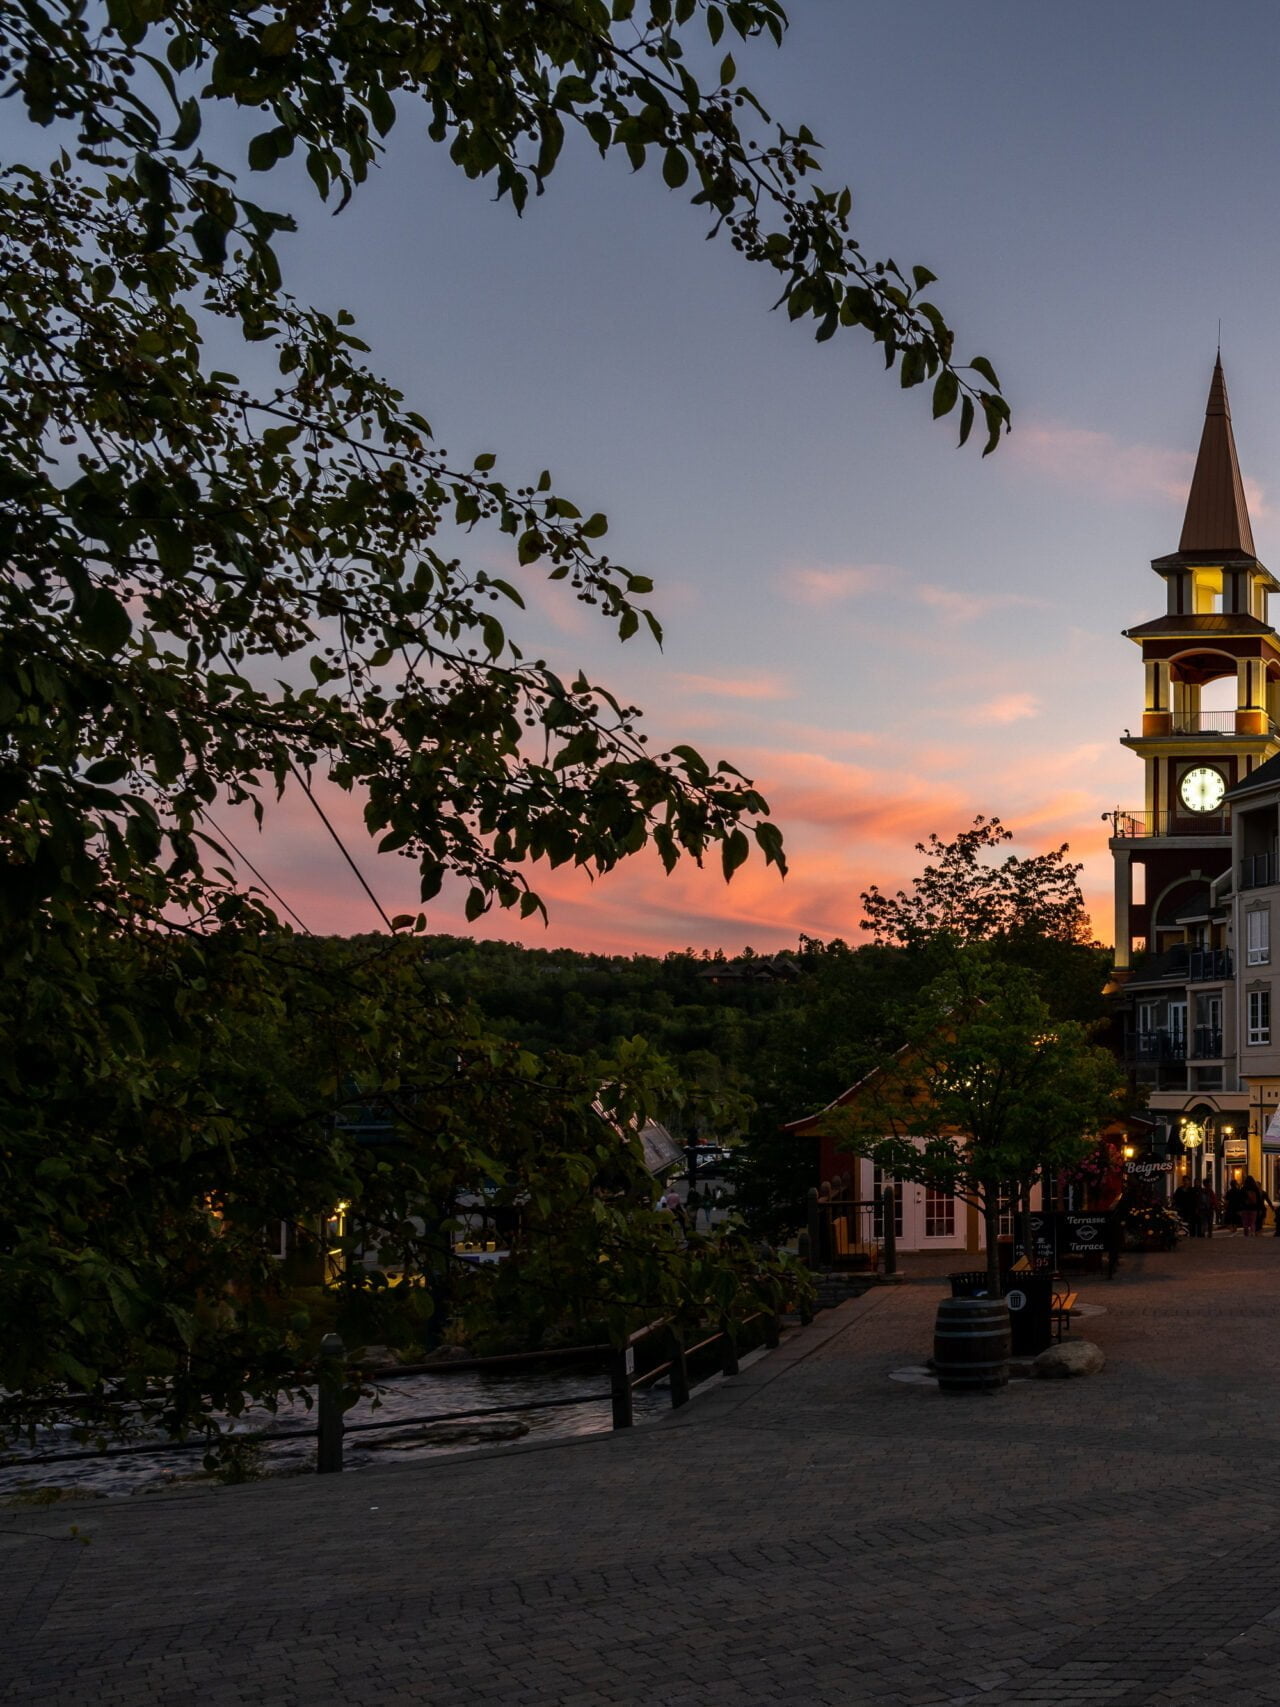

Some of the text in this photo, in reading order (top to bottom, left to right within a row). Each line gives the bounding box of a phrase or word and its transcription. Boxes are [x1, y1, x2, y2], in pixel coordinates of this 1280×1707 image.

[1125, 1161, 1174, 1177] Beignes
[1067, 1215, 1106, 1225] Terrasse
[1069, 1242, 1105, 1251] Terrace
